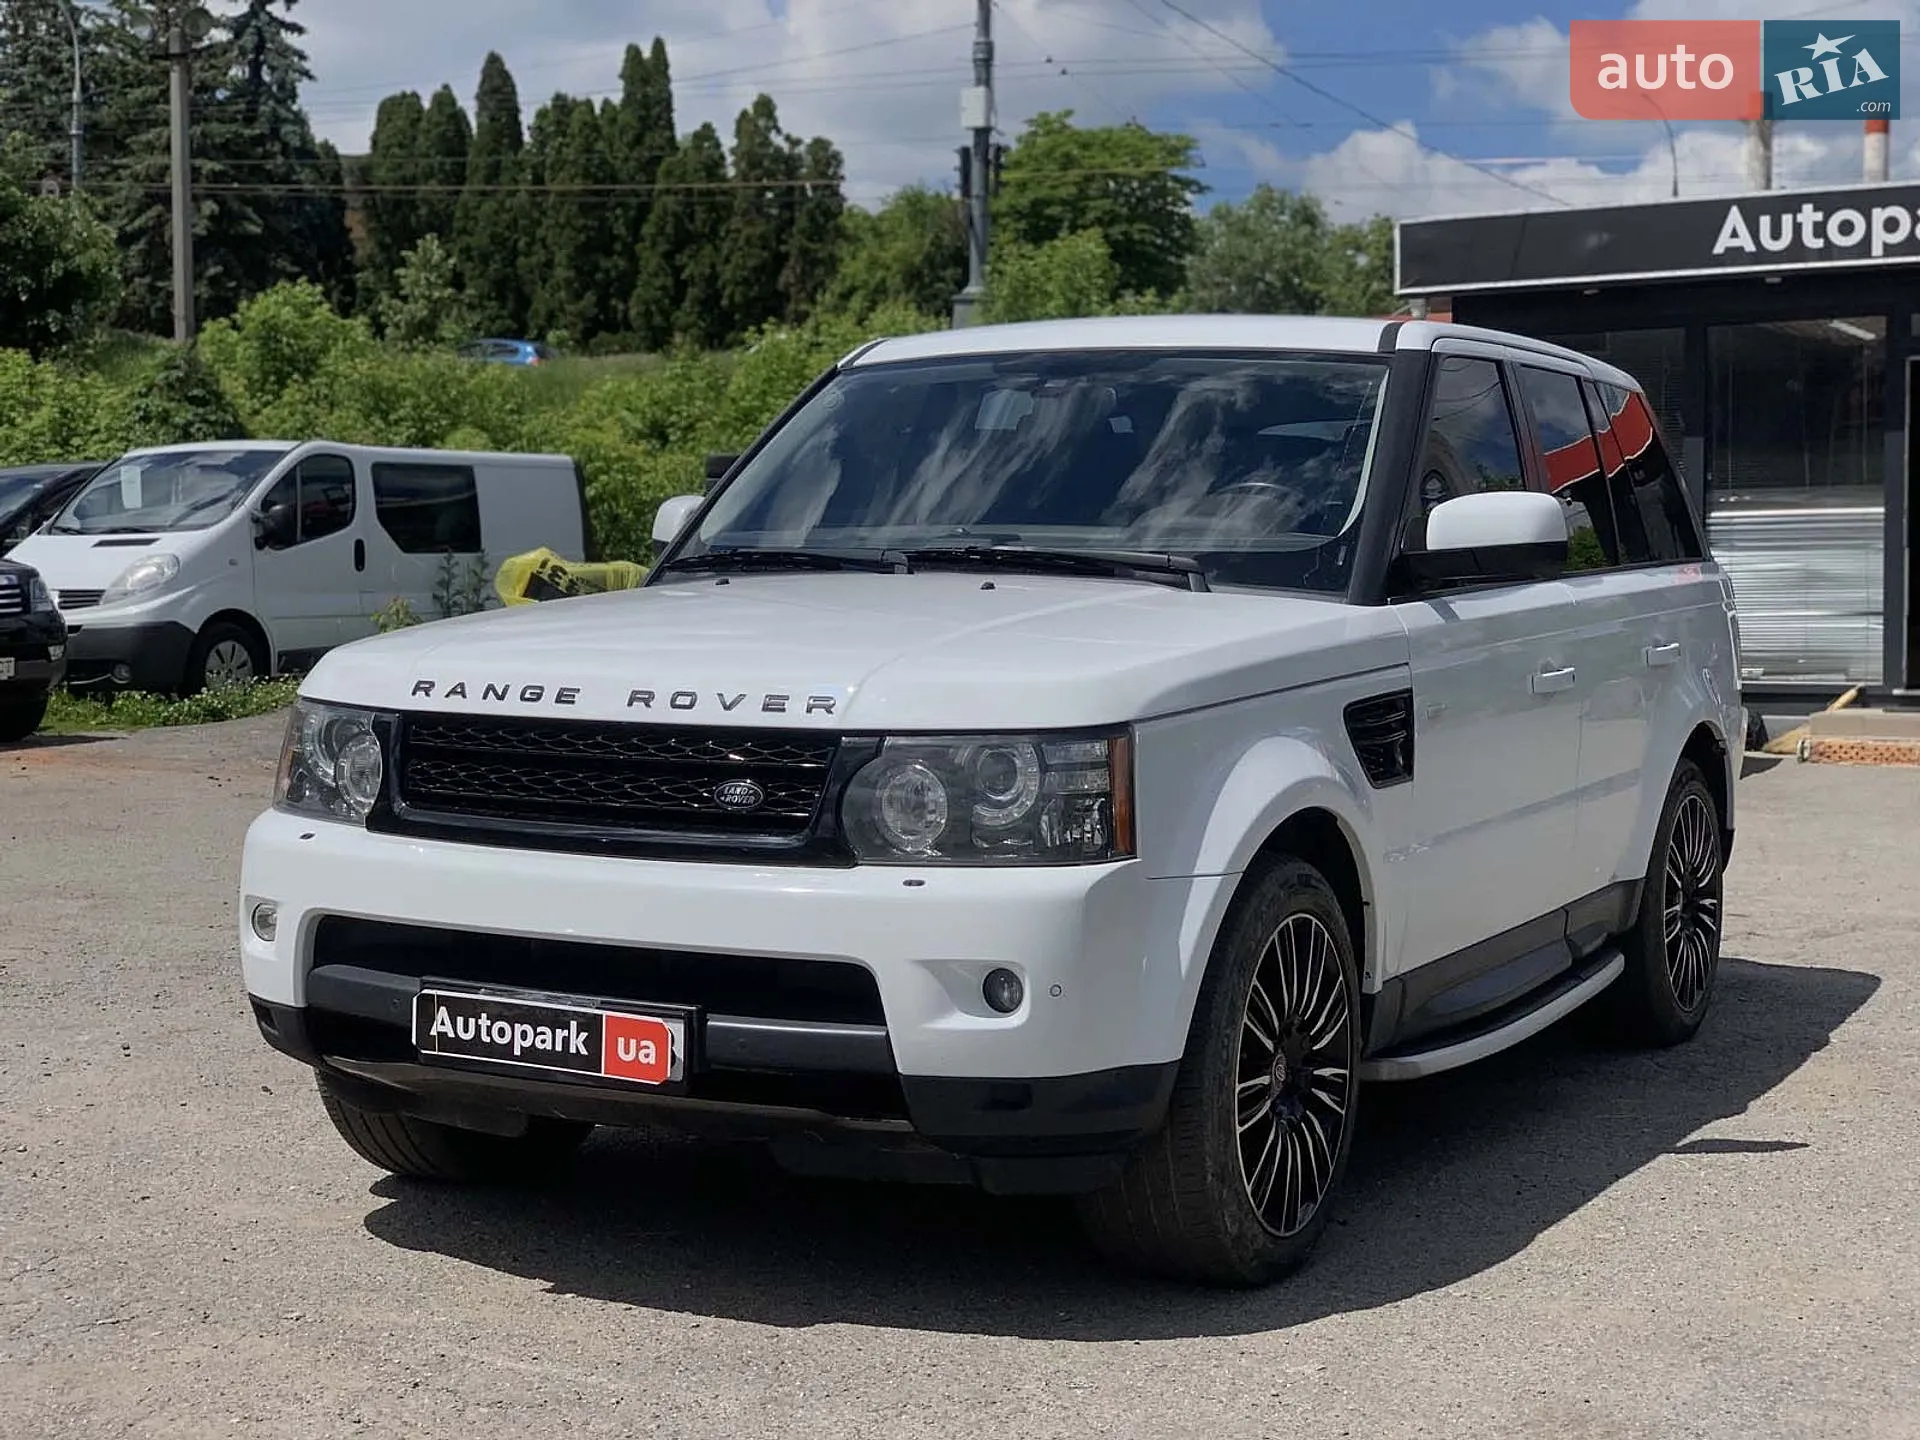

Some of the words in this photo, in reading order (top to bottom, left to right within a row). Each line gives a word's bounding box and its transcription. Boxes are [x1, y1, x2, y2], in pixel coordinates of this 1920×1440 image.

[1712, 203, 1920, 257] Autop
[411, 679, 581, 705] RANGE
[626, 689, 837, 715] ROVER
[724, 786, 749, 795] LAND
[724, 794, 756, 804] ROVER
[429, 1005, 589, 1056] Autopark
[616, 1035, 657, 1065] ua
